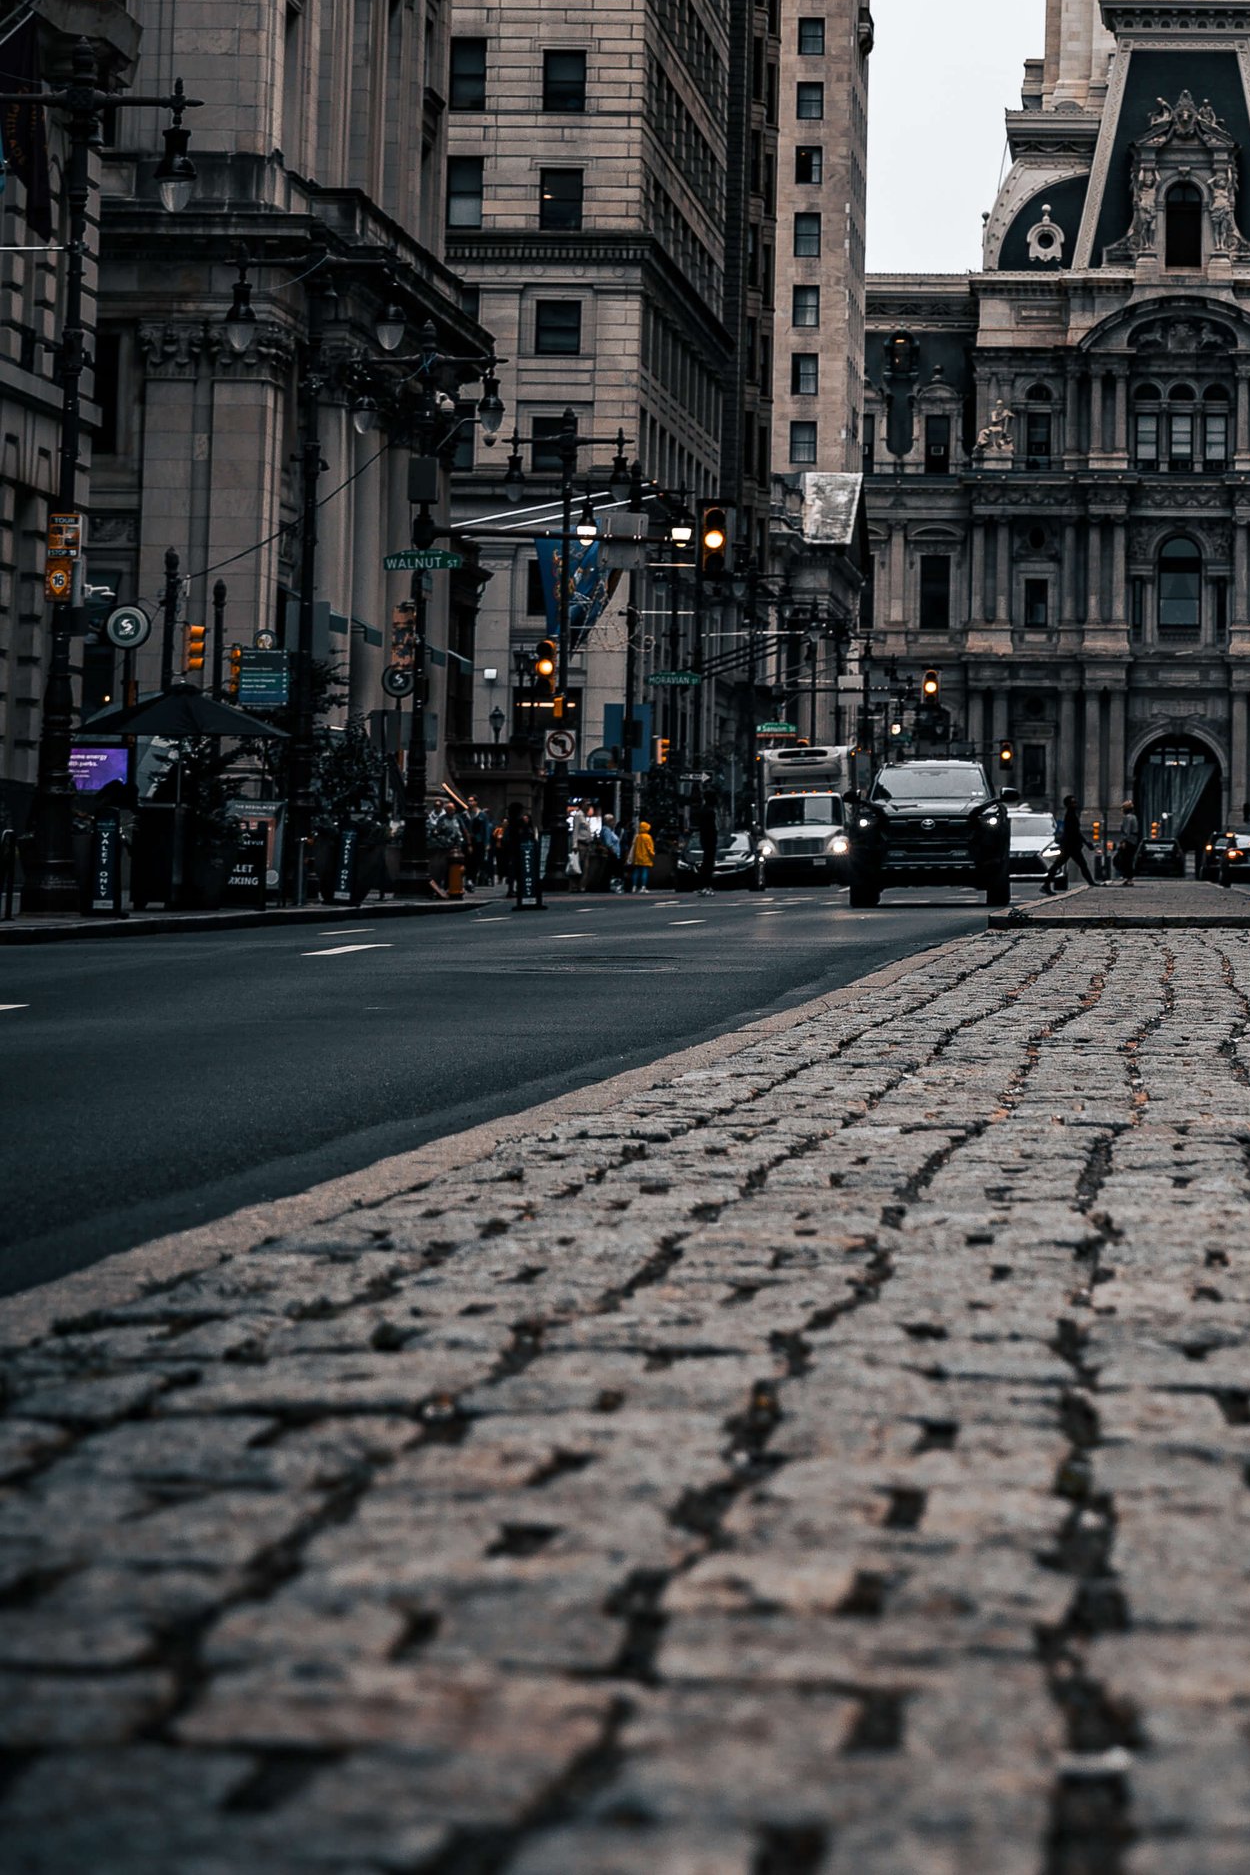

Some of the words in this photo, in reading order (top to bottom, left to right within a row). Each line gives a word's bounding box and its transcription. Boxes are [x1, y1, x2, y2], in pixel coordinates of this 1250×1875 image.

[386, 557, 442, 569] WALNUT
[447, 559, 458, 568] ST
[53, 575, 64, 585] 16
[649, 676, 690, 685] MORAVIAN
[101, 831, 110, 865] VALET
[99, 871, 109, 897] ONLY
